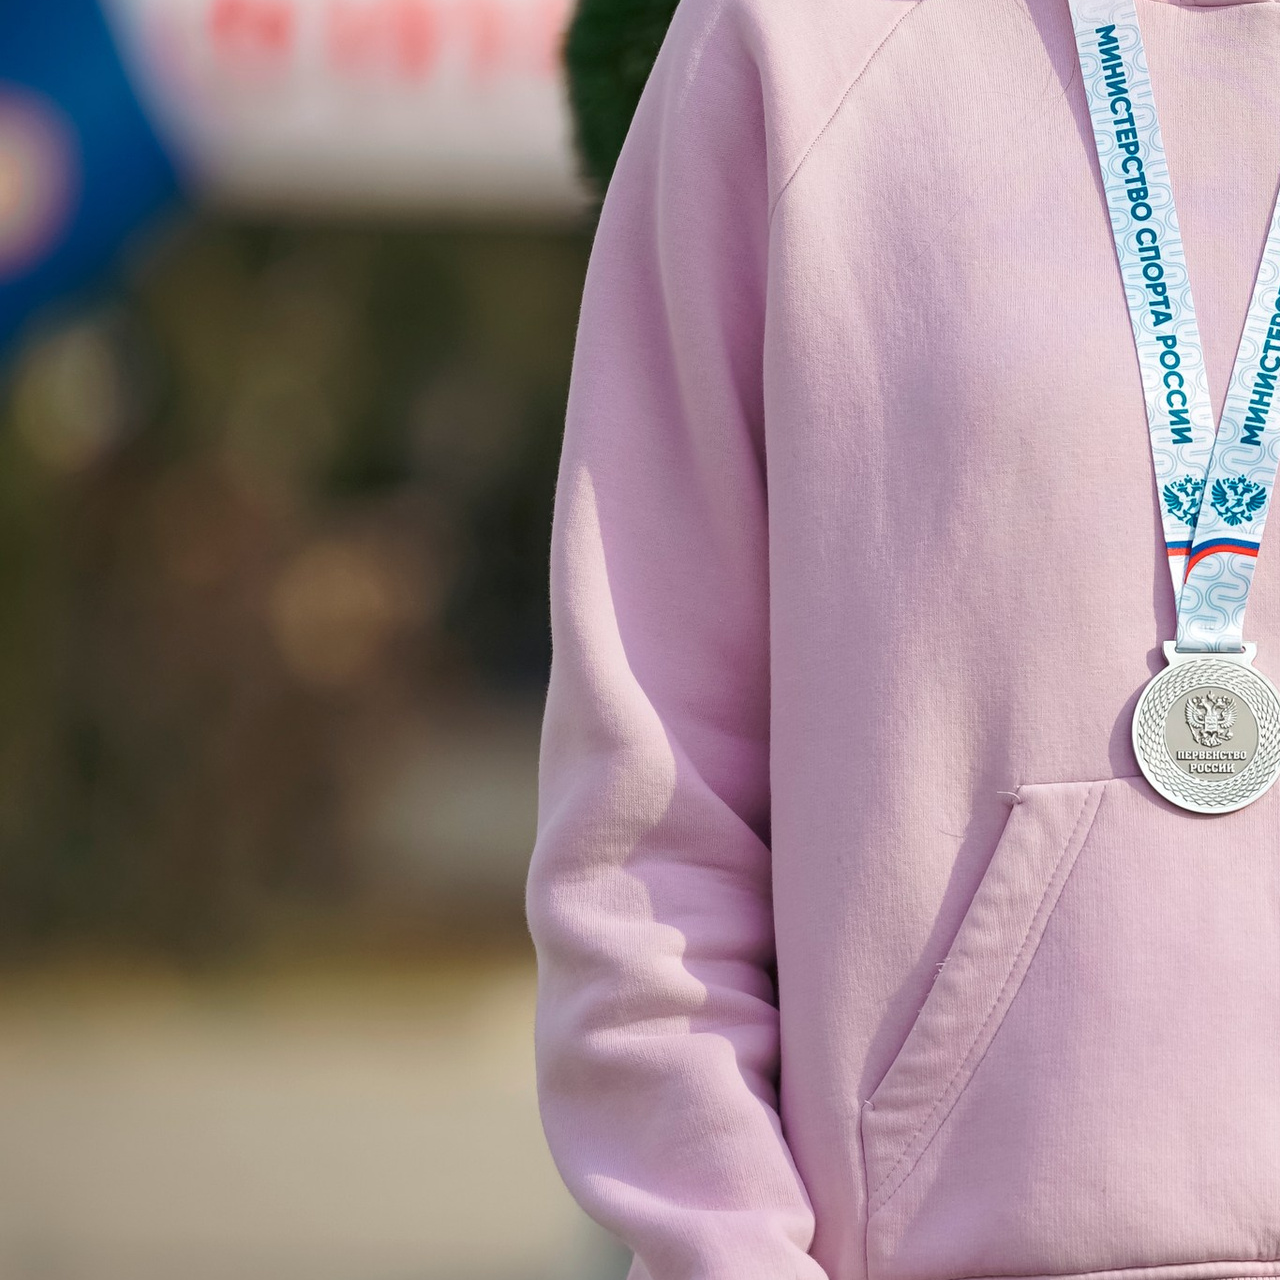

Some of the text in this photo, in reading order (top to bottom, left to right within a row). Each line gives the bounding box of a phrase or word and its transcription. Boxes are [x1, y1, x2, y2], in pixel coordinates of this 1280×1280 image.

[1096, 25, 1193, 445] МИНИСТЕРСТВО СПОРТА РОССИИ
[1176, 751, 1247, 761] ПЕРВЕНСТВО
[1189, 764, 1236, 774] РОССИИ
